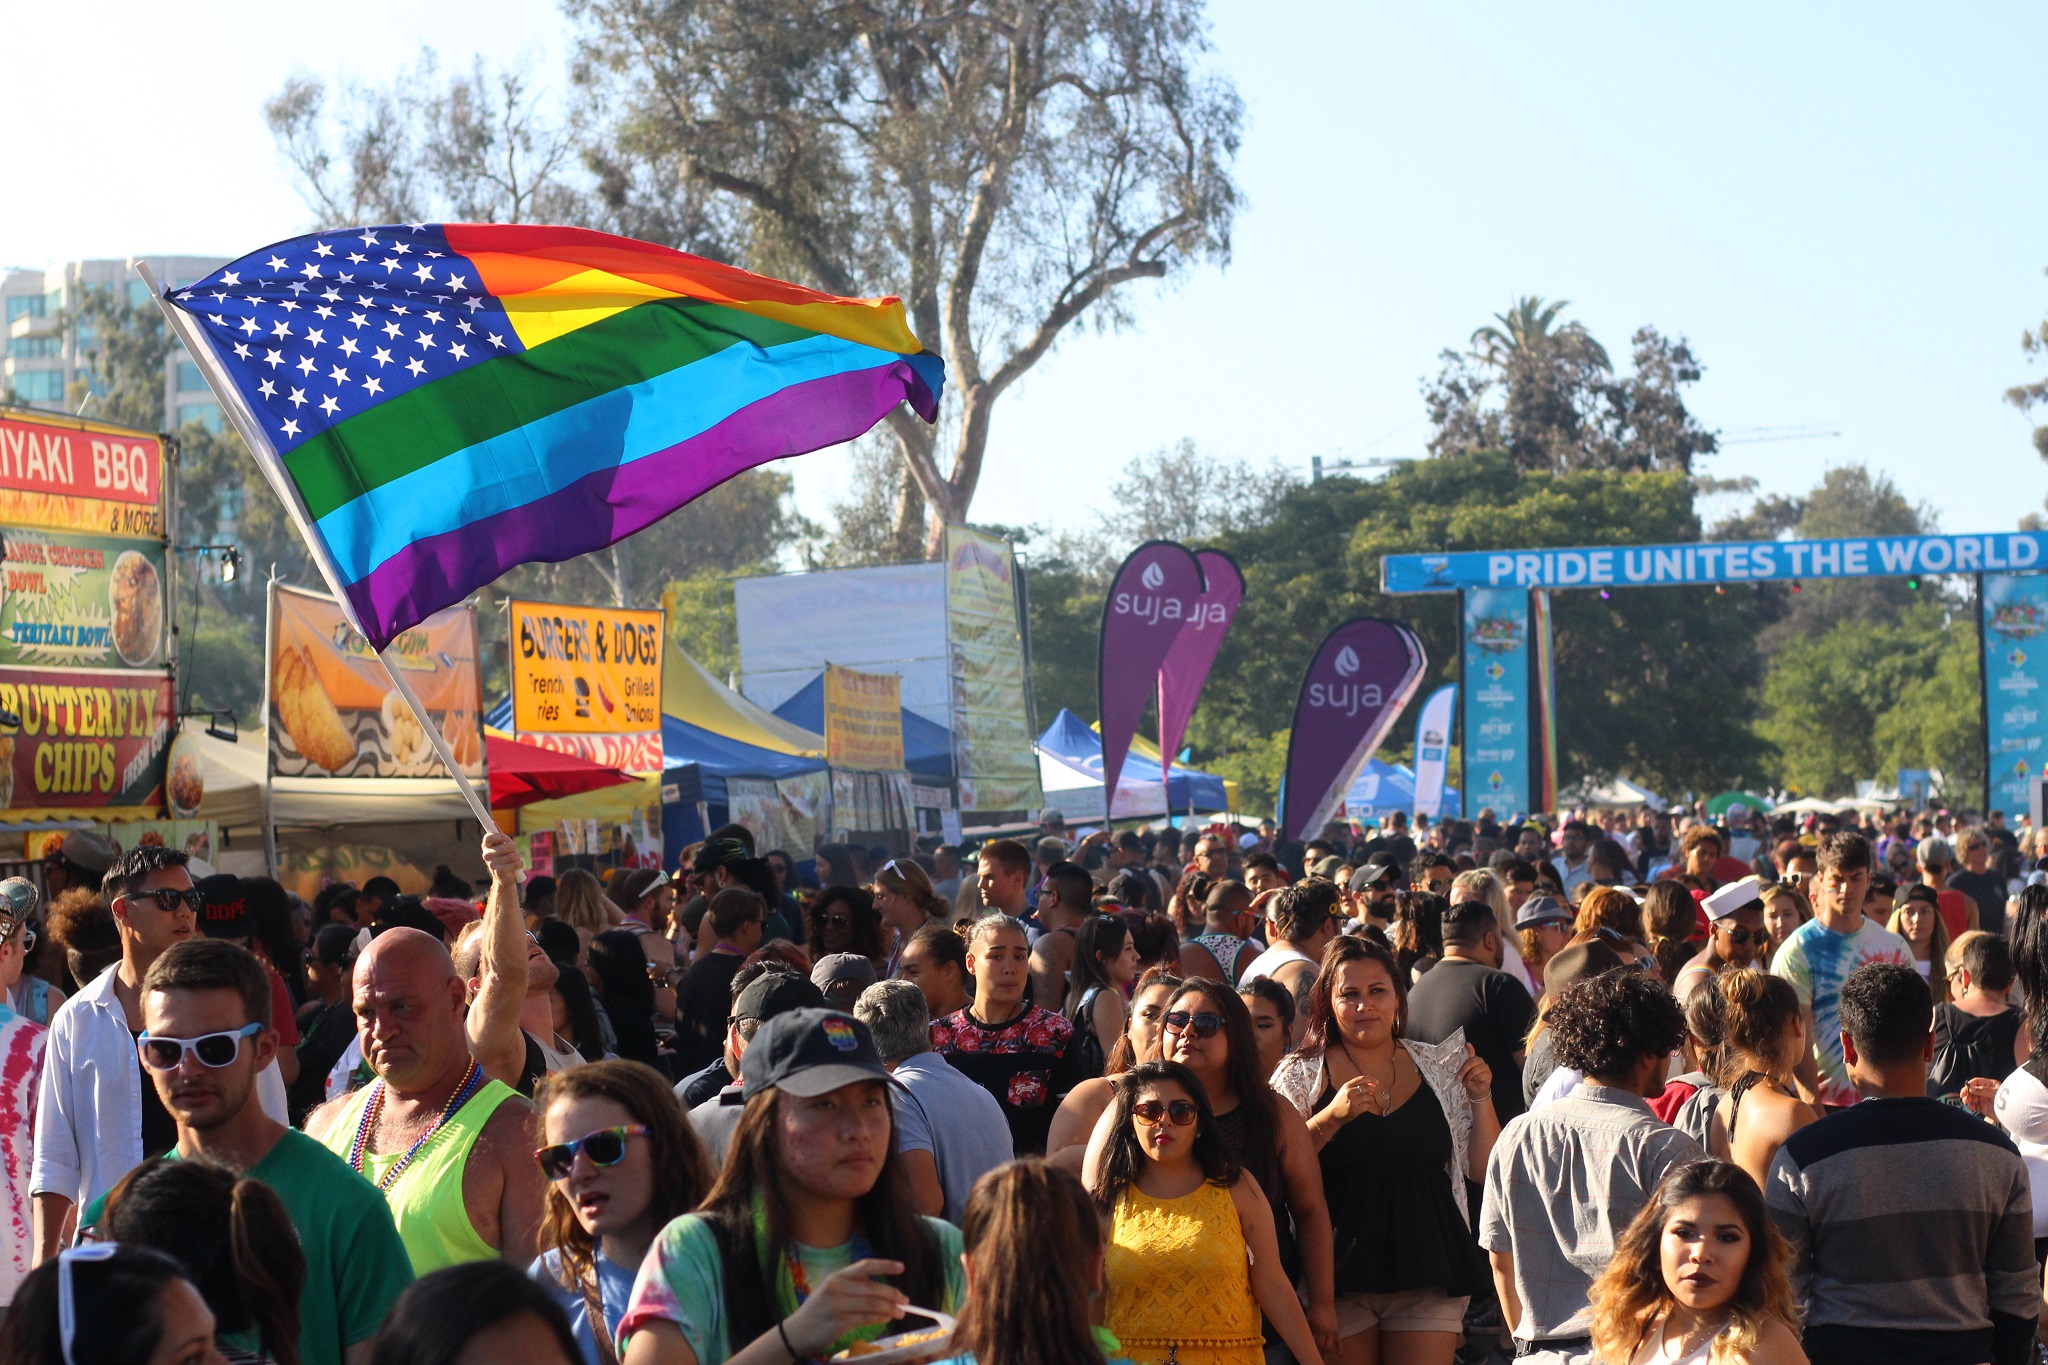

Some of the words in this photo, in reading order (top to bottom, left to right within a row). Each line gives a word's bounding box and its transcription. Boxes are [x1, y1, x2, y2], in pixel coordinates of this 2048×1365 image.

[0, 427, 74, 485] IYAKI
[91, 440, 148, 497] BBQ
[111, 507, 119, 533] &
[122, 508, 158, 536] MORE
[5, 541, 47, 565] ANGE
[48, 544, 105, 569] CHICKEN
[1489, 554, 1614, 585] PRIDE
[1624, 545, 1776, 581] UNITES
[1783, 541, 1868, 575] THE
[1877, 535, 2040, 572] WORLD
[8, 570, 47, 594] BOWL
[1115, 592, 1182, 625] suja
[12, 622, 74, 646] TERIYAKI
[76, 626, 111, 648] BOWL
[521, 615, 591, 663] BURGERS
[596, 620, 608, 663] &
[614, 622, 656, 666] DOGS
[529, 672, 564, 694] rench
[625, 677, 654, 697] Grilled
[1309, 682, 1382, 717] suja
[0, 682, 158, 738] BUTTERFLY
[537, 699, 559, 721] ries
[34, 741, 116, 794] CHIPS
[122, 741, 150, 794] FRESH
[602, 732, 663, 771] DOGS
[206, 897, 247, 921] DOPE
